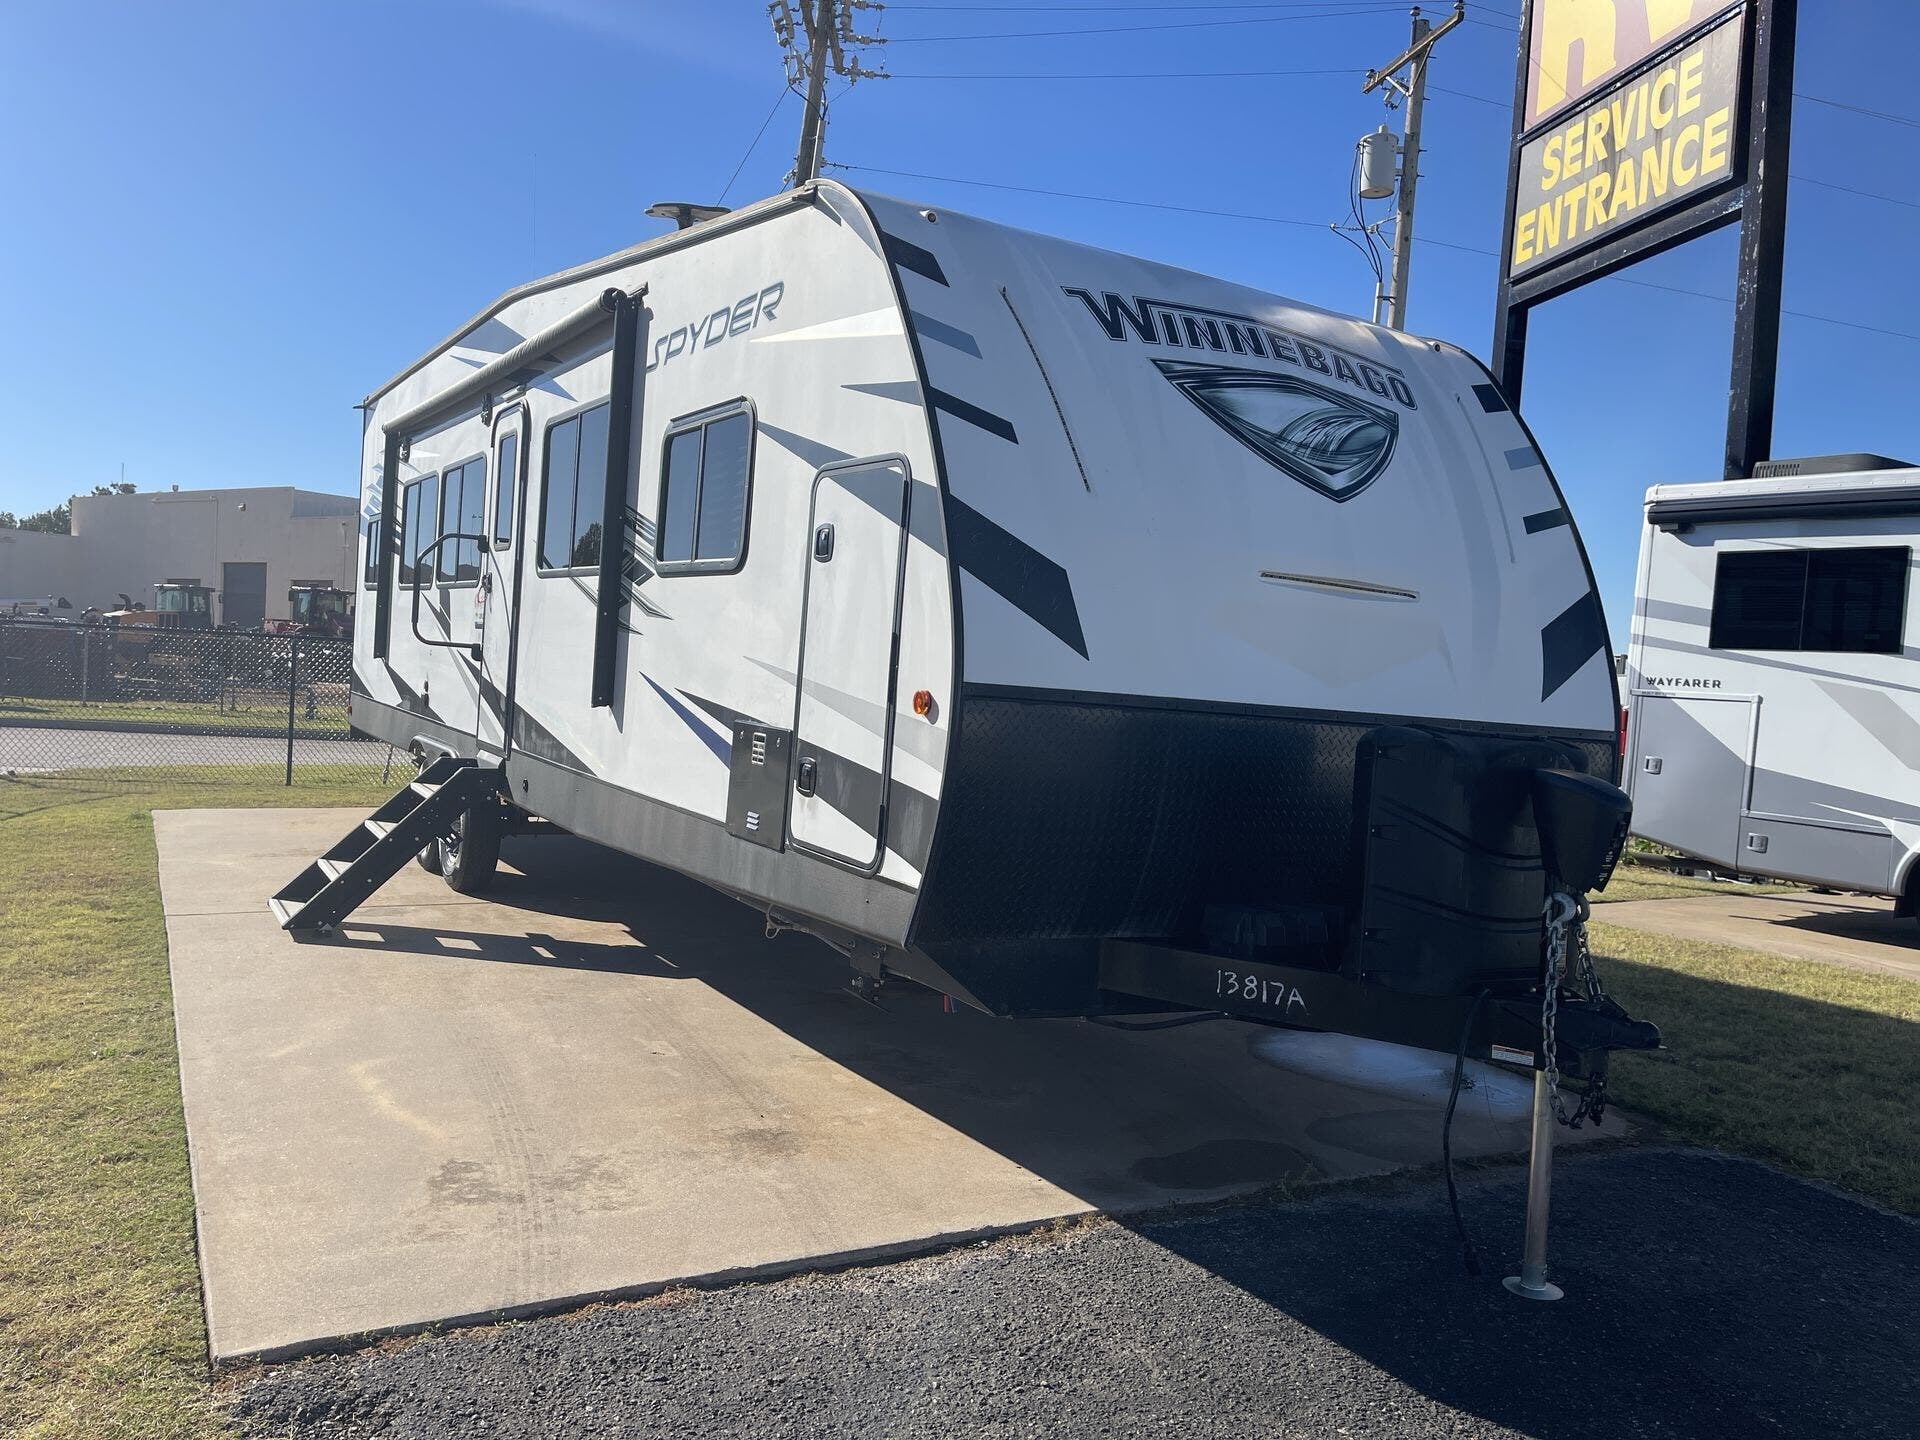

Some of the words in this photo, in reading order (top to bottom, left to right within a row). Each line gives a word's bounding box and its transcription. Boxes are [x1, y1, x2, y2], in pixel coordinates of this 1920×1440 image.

[1541, 50, 1704, 192] SERVICE
[1514, 106, 1730, 265] ENTRANCE
[646, 280, 785, 374] SPYDER
[1060, 286, 1418, 410] WINNEBAGO
[1646, 677, 1721, 689] WAYFARER
[1216, 969, 1310, 1015] 13817A
